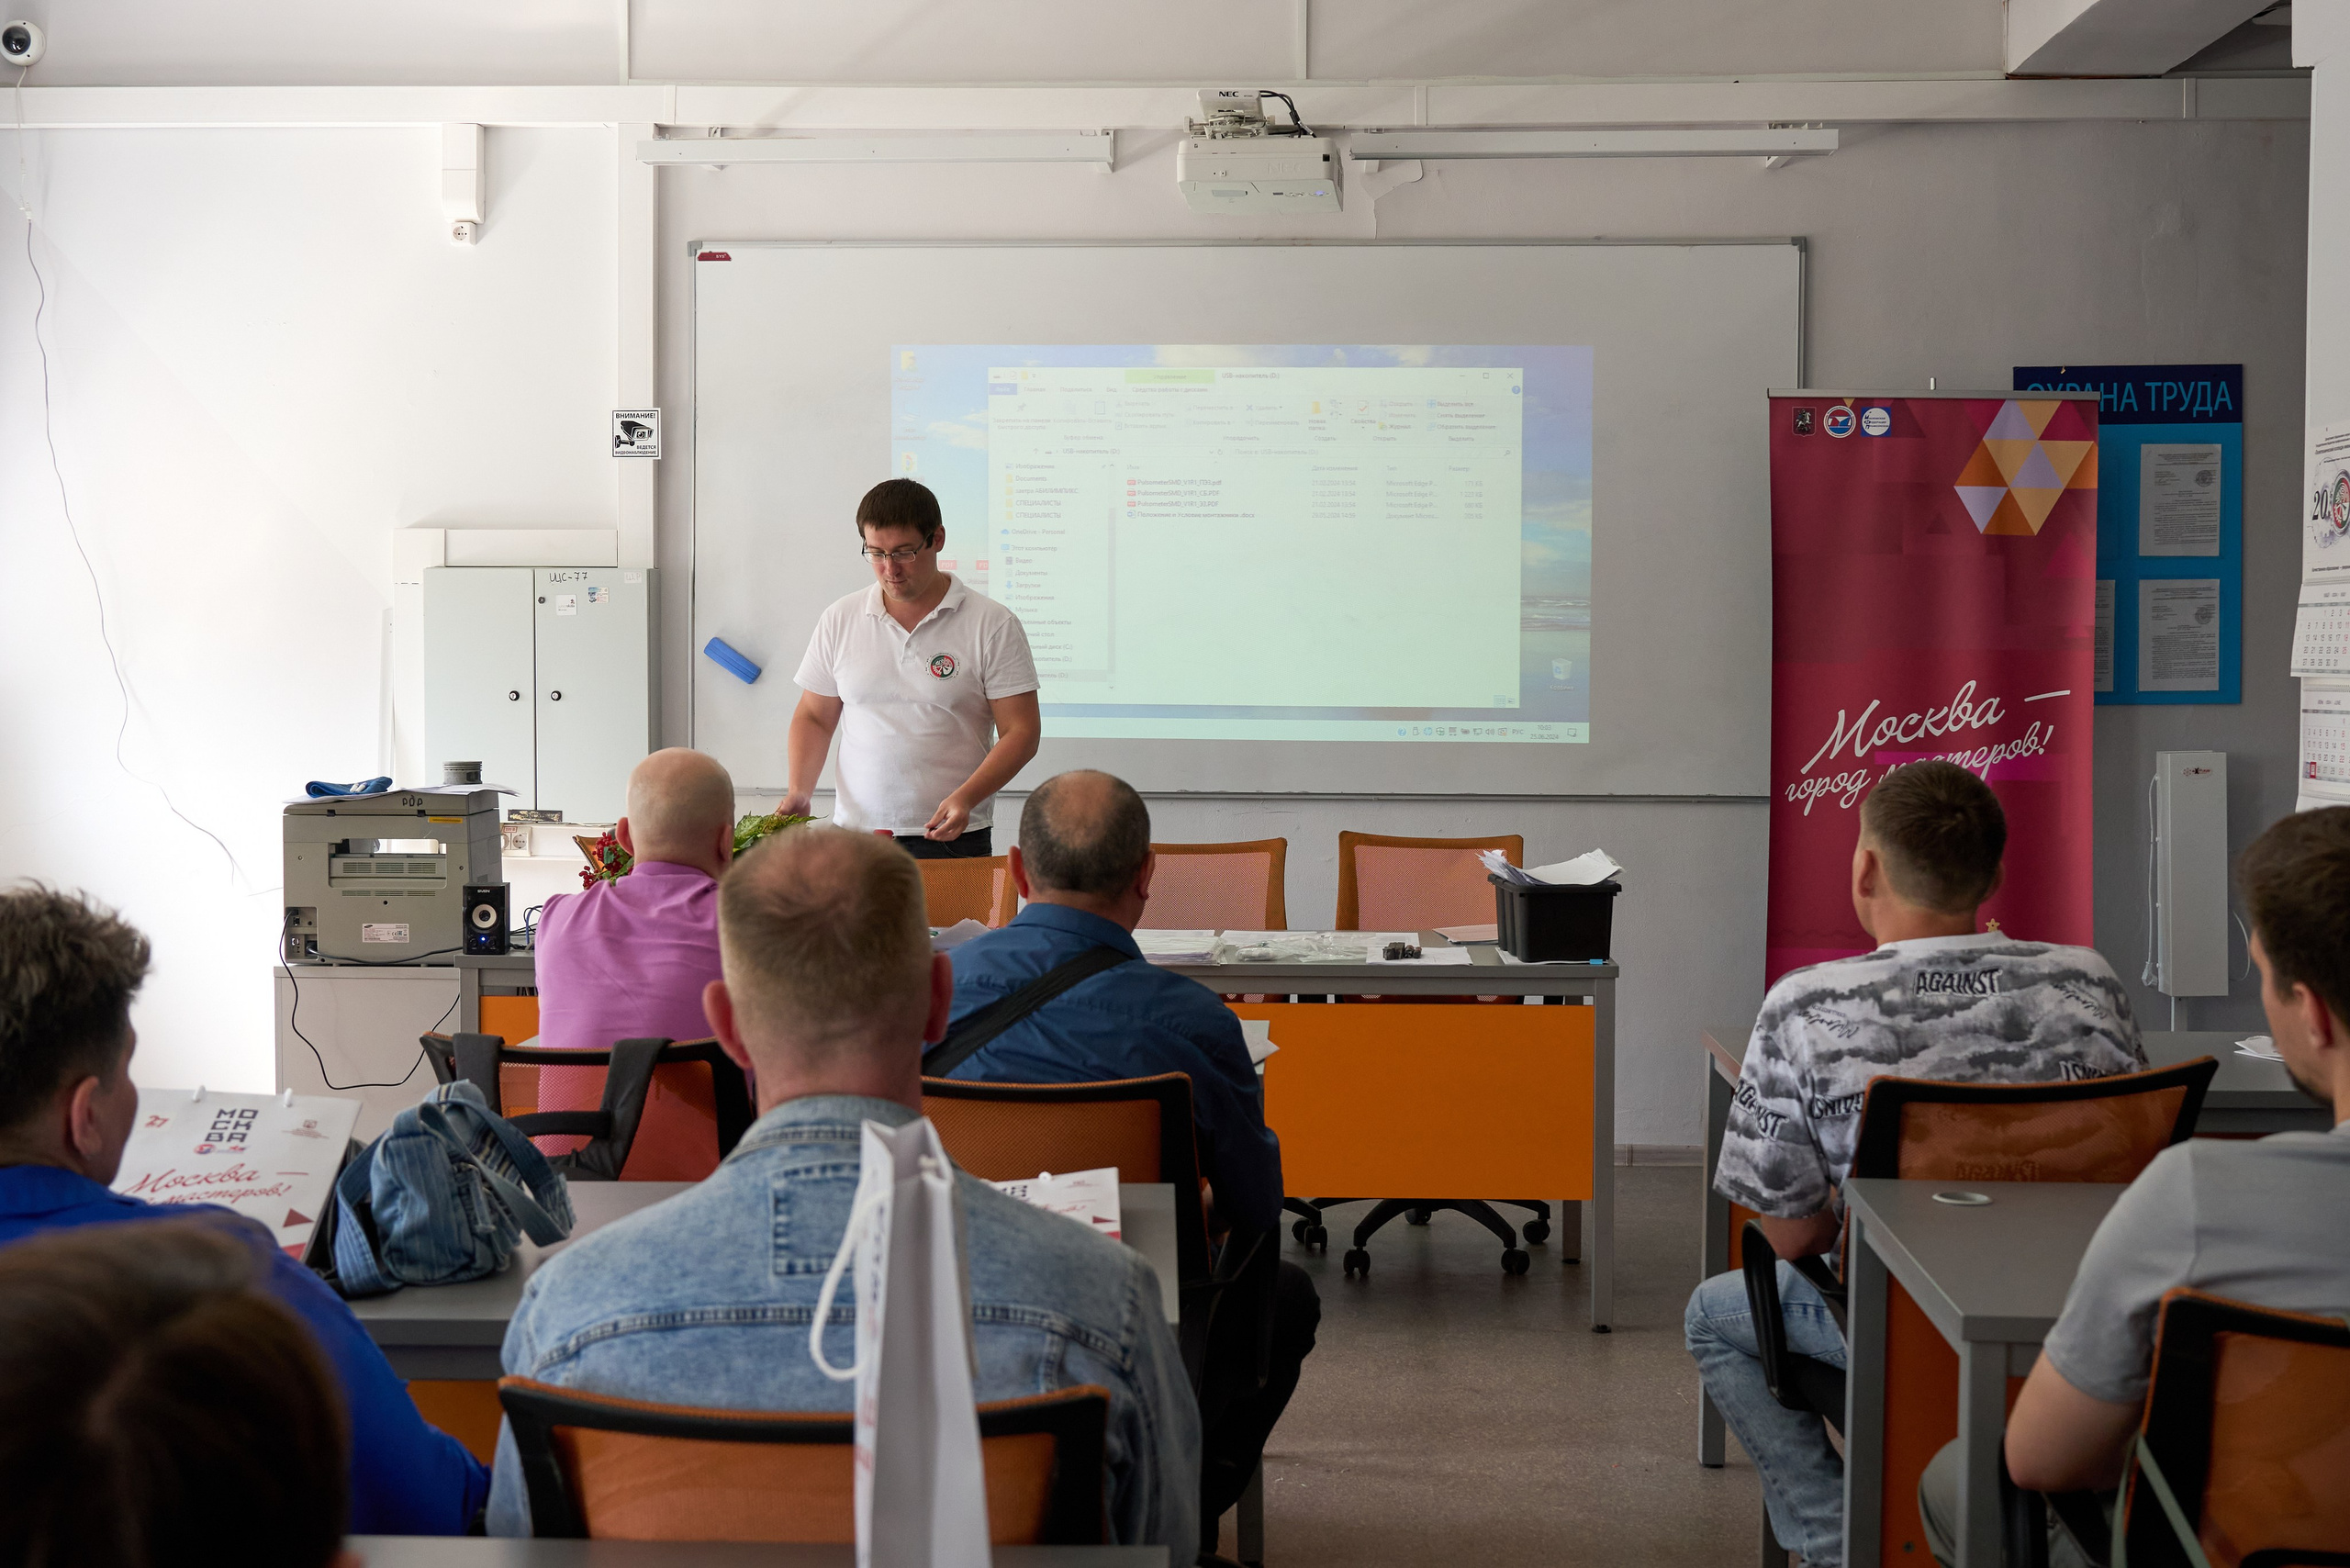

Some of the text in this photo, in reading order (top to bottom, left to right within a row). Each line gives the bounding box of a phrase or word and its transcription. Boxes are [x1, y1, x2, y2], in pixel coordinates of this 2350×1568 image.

[2144, 380, 2233, 419] ТРУДА
[1800, 680, 2006, 775] Москва
[1785, 721, 2055, 816] город теров!
[1915, 967, 2002, 997] AGAINST
[121, 1163, 261, 1196] Москва
